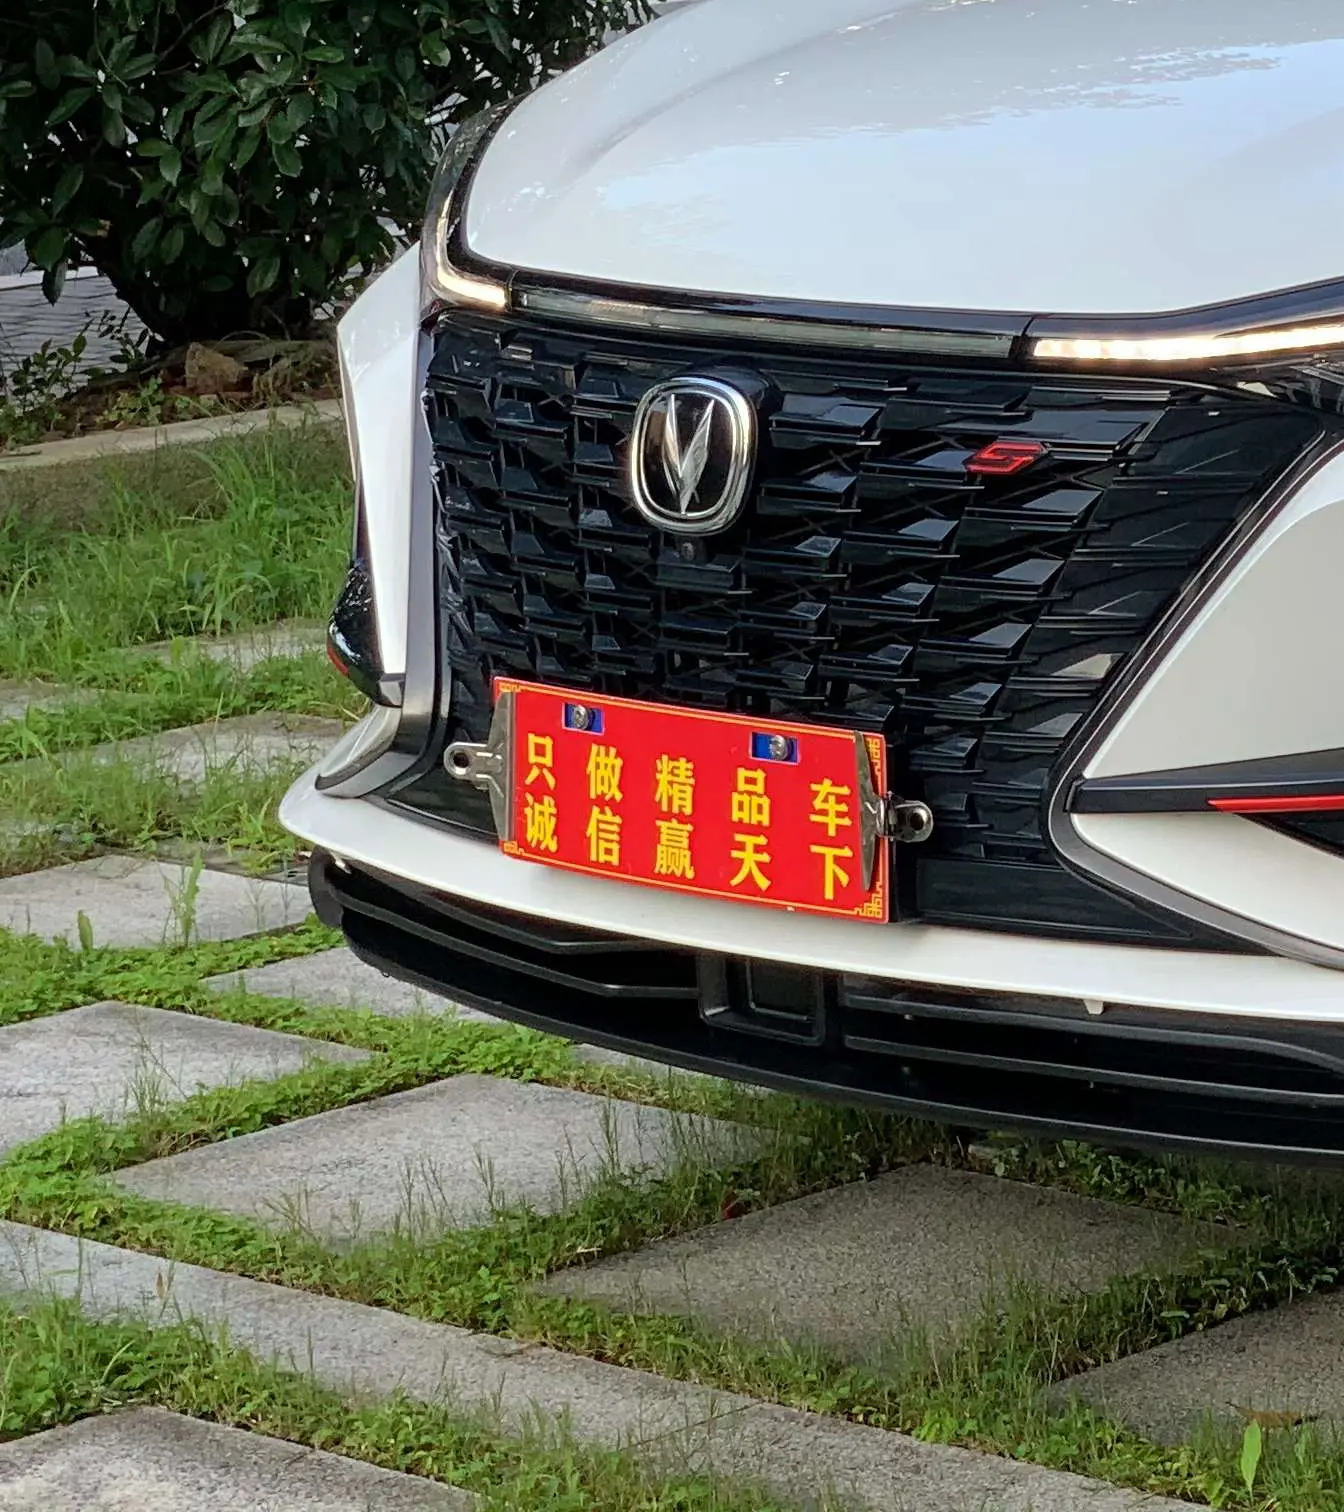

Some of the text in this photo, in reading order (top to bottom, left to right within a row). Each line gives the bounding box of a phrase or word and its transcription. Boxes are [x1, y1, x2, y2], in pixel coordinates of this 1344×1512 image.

[523, 733, 853, 838] 只做精品车
[523, 792, 855, 901] 诚信赢天下
